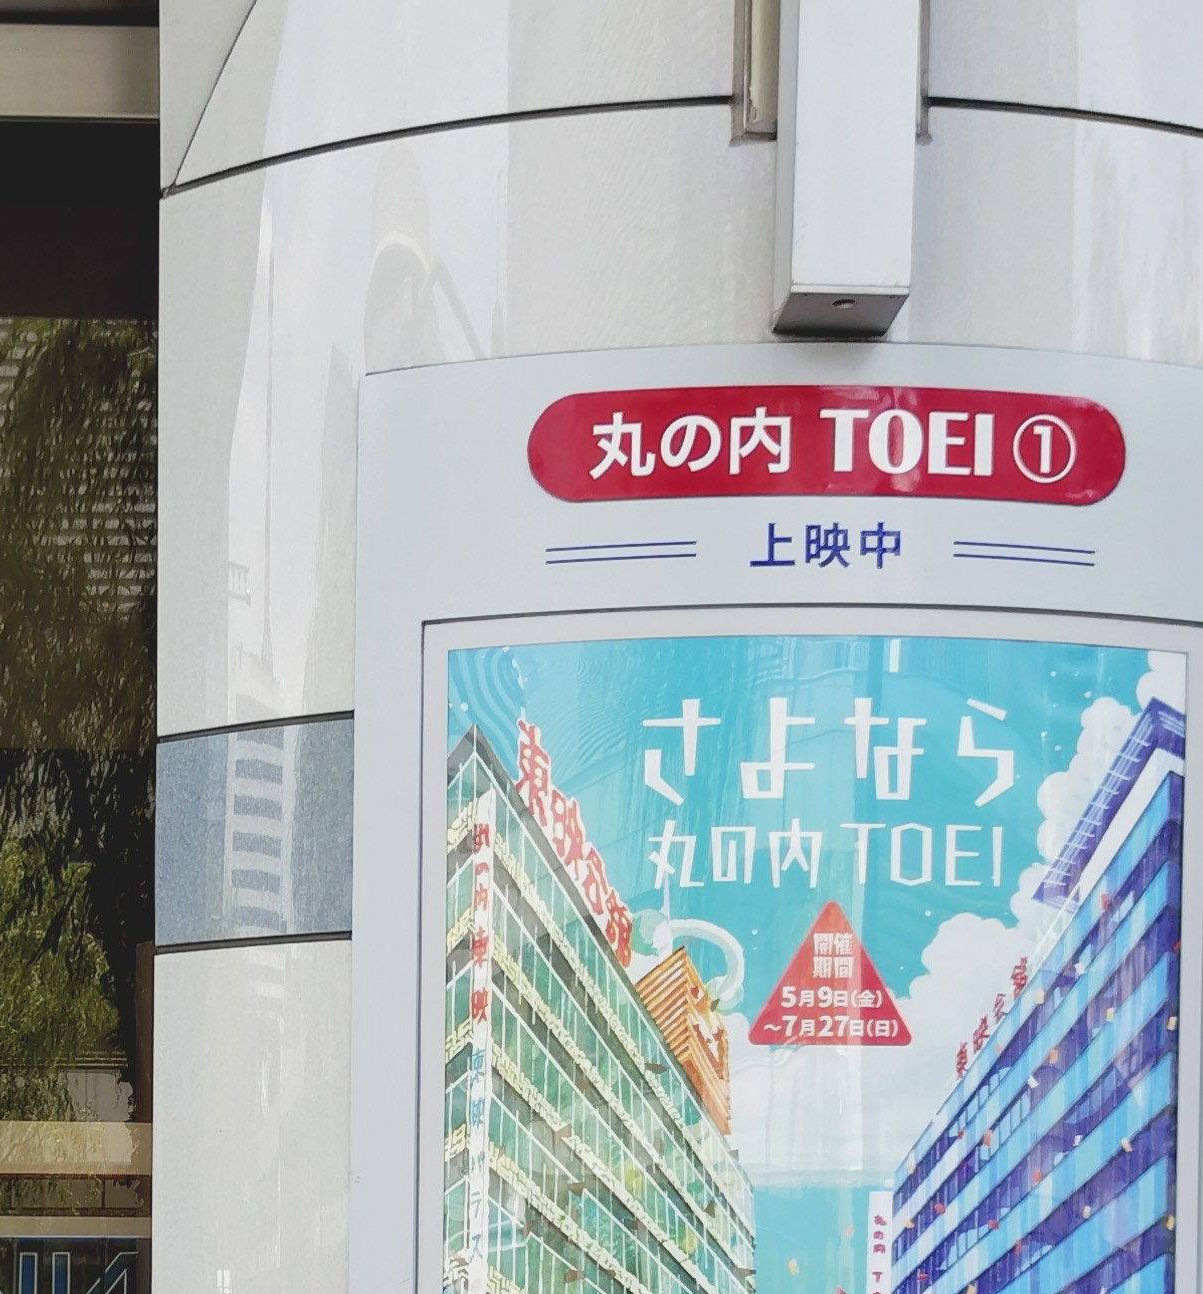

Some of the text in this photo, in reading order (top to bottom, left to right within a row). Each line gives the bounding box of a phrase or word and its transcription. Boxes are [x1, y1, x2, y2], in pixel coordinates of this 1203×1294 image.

[590, 406, 792, 479] 丸の内
[820, 408, 996, 476] TOEI
[750, 521, 901, 569] 上映中
[642, 697, 1015, 807] さよなら
[647, 818, 1004, 890] 丸の内 TOEI
[812, 956, 855, 979] 期間
[813, 932, 854, 955] 開催
